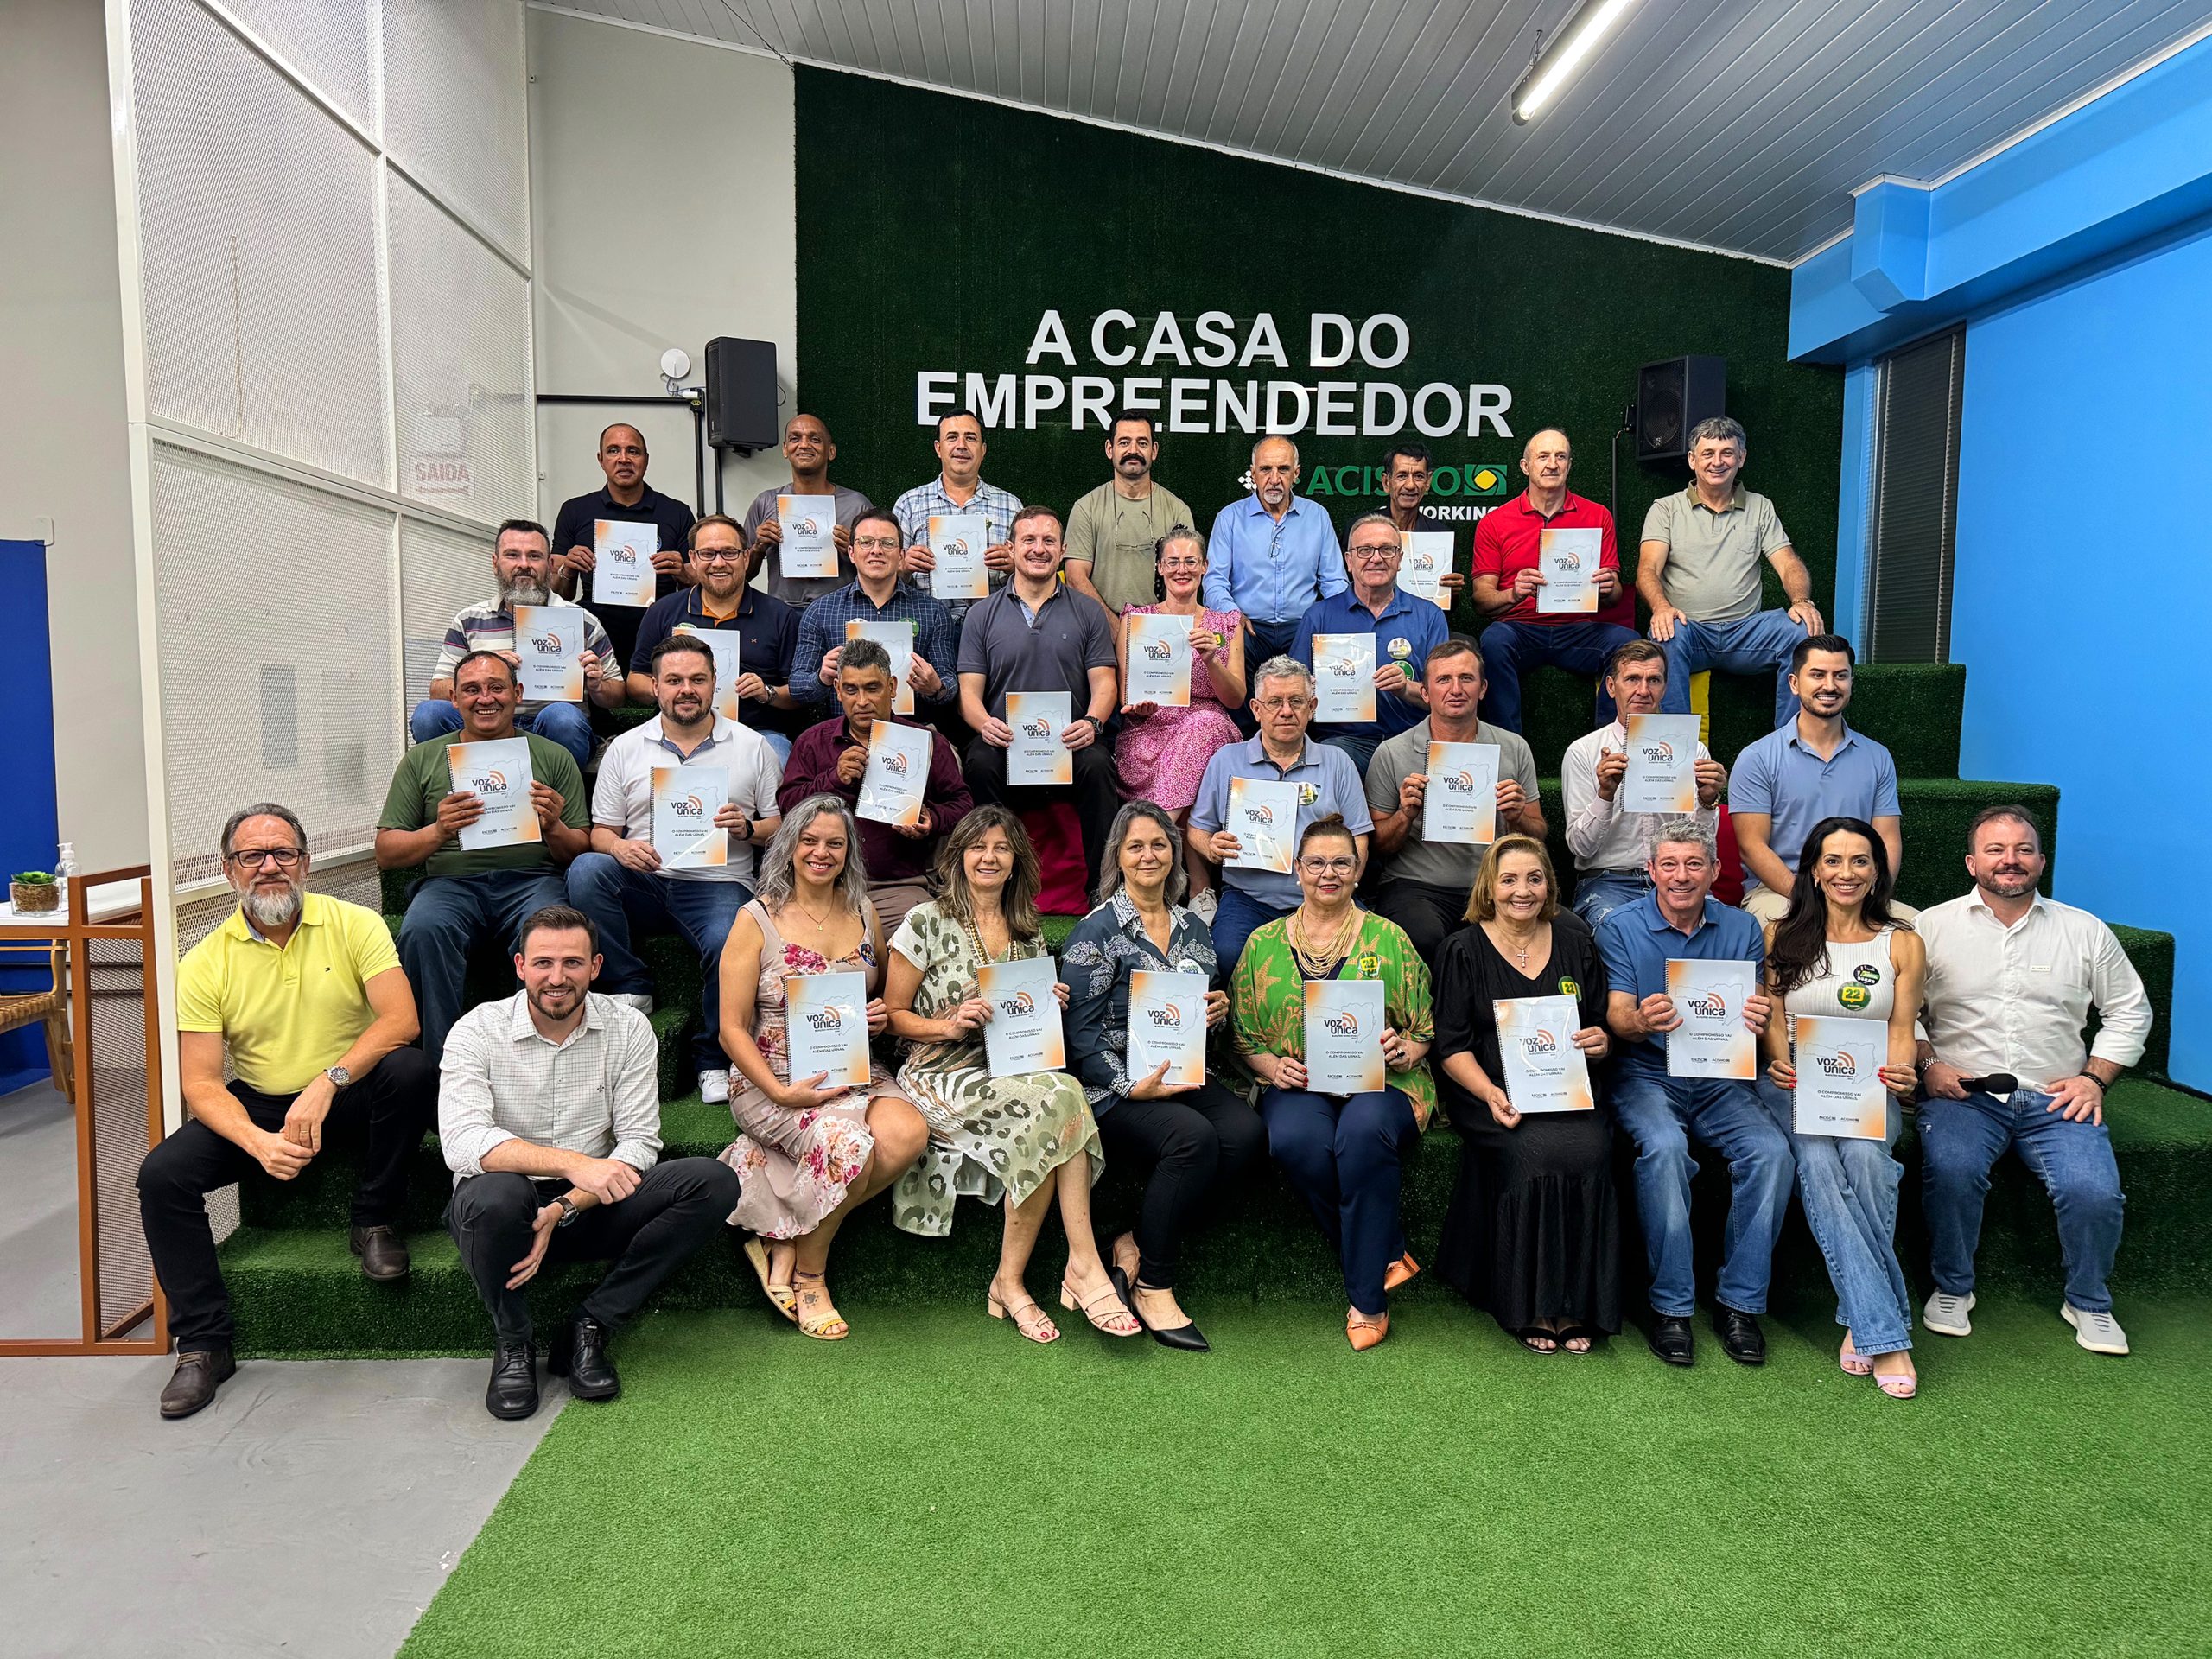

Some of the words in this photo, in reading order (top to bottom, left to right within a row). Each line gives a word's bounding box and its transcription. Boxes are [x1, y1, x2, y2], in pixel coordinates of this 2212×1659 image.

[1026, 310, 1077, 365] A
[1091, 309, 1289, 367] CASA
[1310, 313, 1409, 368] DO
[918, 372, 1514, 438] EMPREENDEDOR
[1306, 466, 1460, 496] ACIO
[1845, 988, 1860, 999] 22
